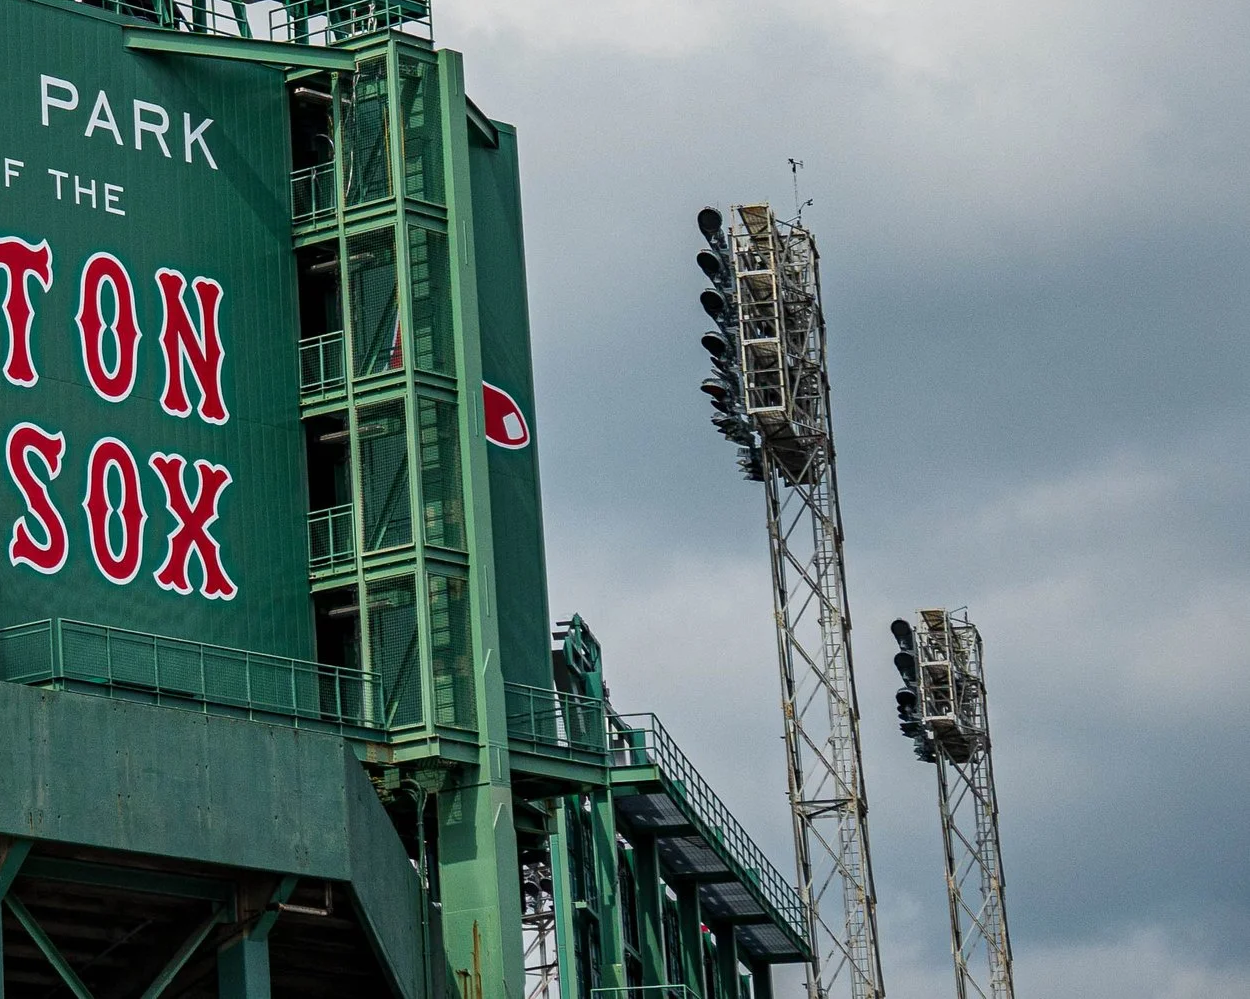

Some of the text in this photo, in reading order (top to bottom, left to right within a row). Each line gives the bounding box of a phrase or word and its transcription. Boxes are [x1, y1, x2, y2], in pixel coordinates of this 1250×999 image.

[40, 73, 219, 170] PARK
[47, 168, 126, 216] THE
[5, 421, 239, 601] SOX
